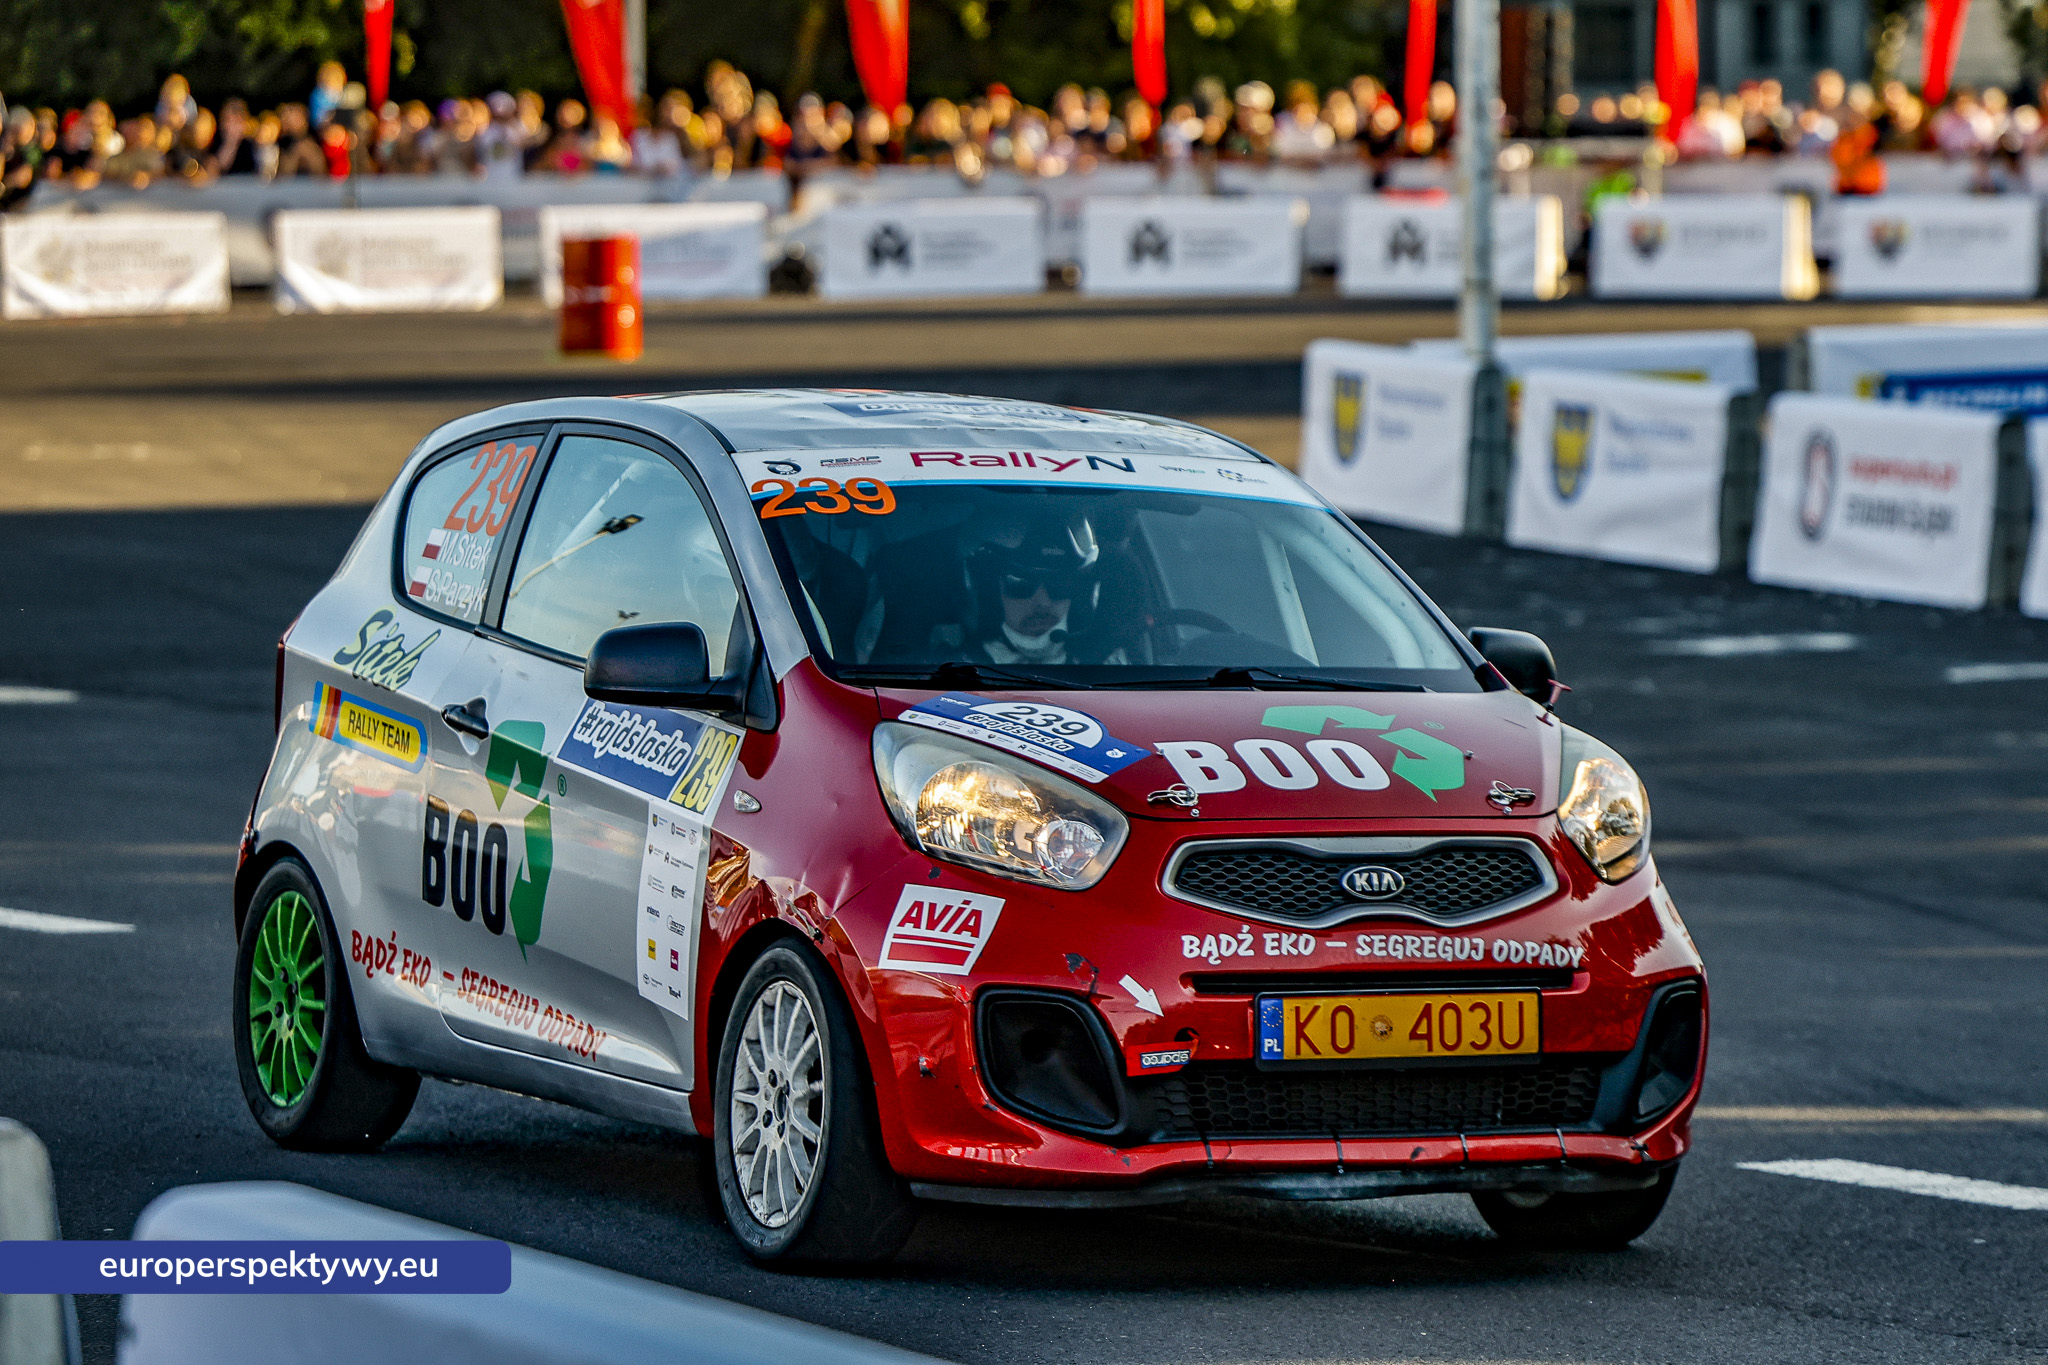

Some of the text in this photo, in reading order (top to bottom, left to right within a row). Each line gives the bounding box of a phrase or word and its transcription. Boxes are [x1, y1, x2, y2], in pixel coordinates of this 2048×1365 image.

[909, 451, 1136, 472] RallyN
[443, 441, 537, 537] 239
[751, 477, 897, 519] 239
[347, 708, 411, 754] RALLY TEAM
[575, 703, 690, 775] #rajdslaska
[964, 713, 1073, 751] #rajdslaska
[996, 705, 1091, 737] 239
[669, 727, 737, 812] 239
[1152, 738, 1391, 794] BOO
[422, 793, 508, 936] BOO
[1353, 871, 1397, 892] KIA
[897, 899, 982, 938] AVIA
[1181, 924, 1254, 965] BĄDŹ
[1263, 932, 1316, 956] EKO
[1356, 934, 1485, 962] SEGREGUJ
[1492, 939, 1584, 969] ODPADY
[352, 929, 397, 978] BĄDŹ
[401, 948, 431, 988] EKO
[457, 966, 539, 1031] SEGREGUJ
[538, 1004, 607, 1062] ODPADY
[1264, 1038, 1281, 1053] PL
[1409, 1000, 1525, 1053] 403U
